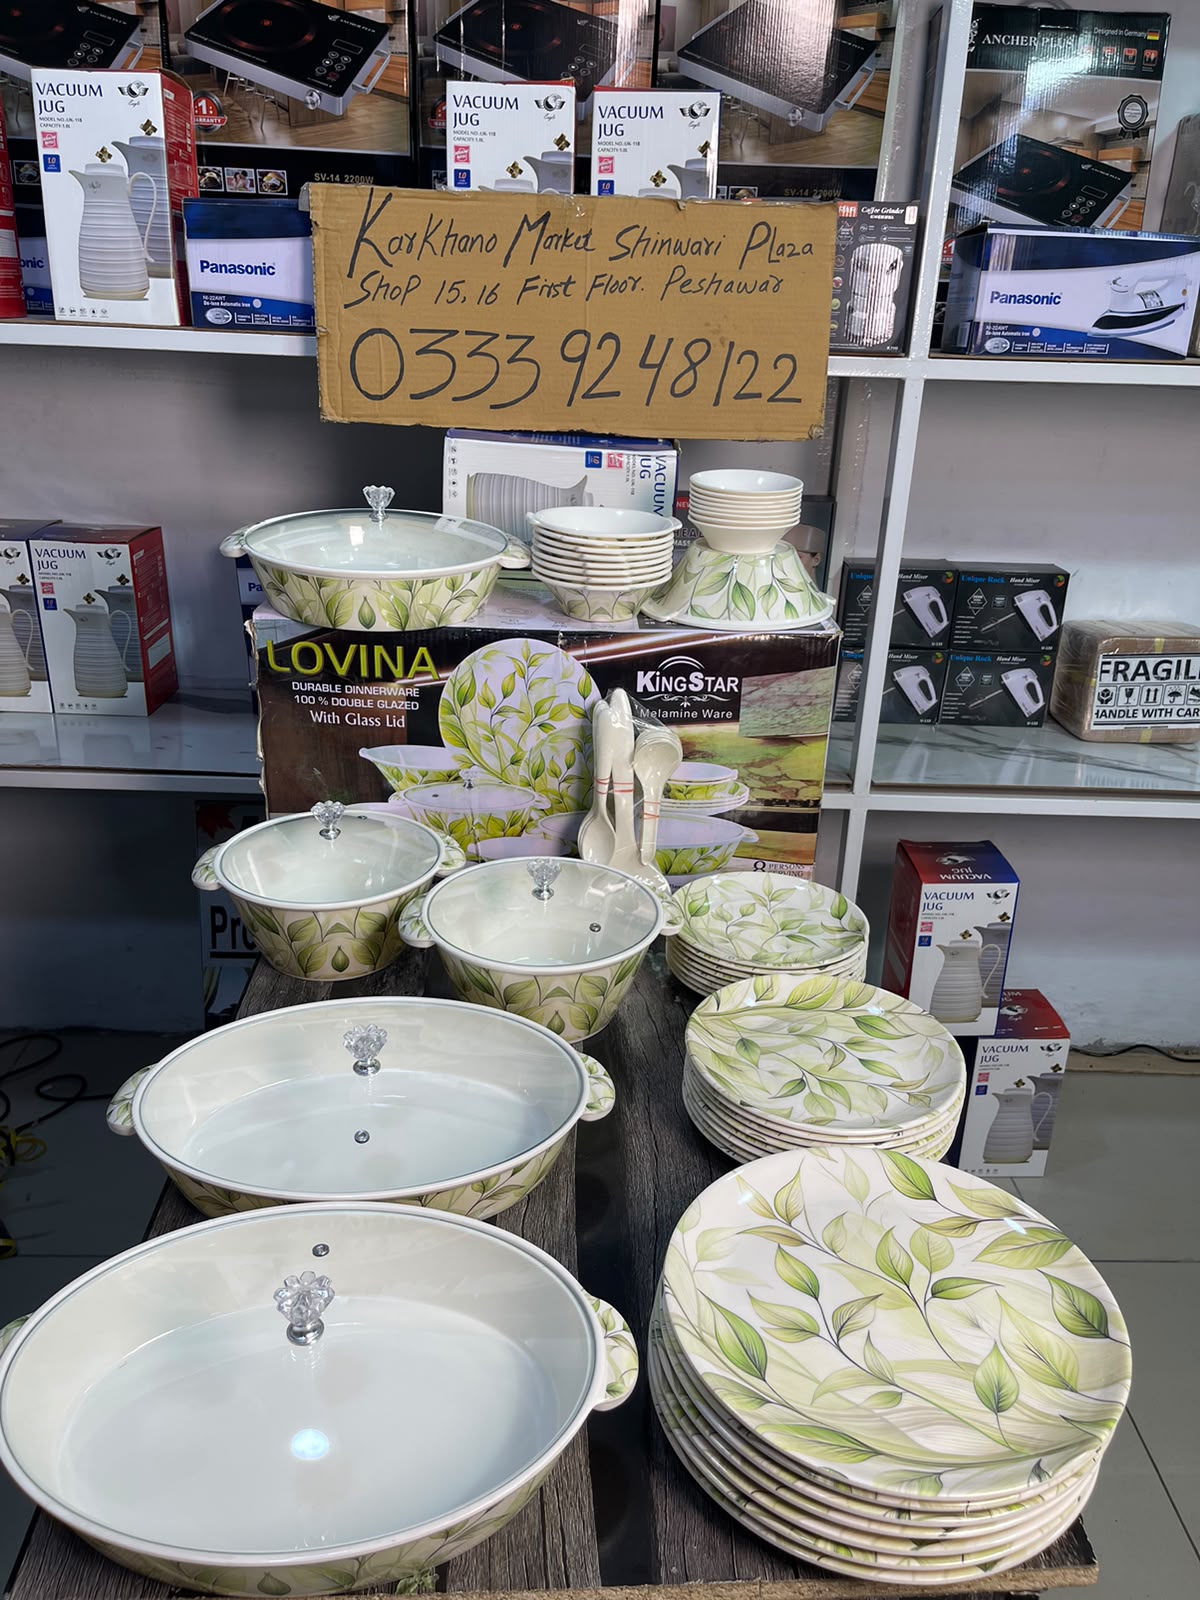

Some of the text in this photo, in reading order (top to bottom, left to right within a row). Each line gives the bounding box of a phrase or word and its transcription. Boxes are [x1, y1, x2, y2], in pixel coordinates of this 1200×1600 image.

[982, 34, 1038, 47] ANCHER
[36, 82, 103, 97] VACUUM
[39, 100, 65, 115] JUG
[453, 95, 519, 111] VACUUM
[598, 106, 664, 119] VACUUM
[453, 113, 480, 129] JUG
[598, 124, 625, 140] JUG
[314, 172, 374, 184] SV-14 2200W
[784, 188, 809, 197] SV-14
[861, 206, 881, 215] Coffee
[608, 224, 726, 262] Shinwari
[200, 260, 276, 276] Panasonic
[660, 265, 784, 302] Peshawar
[990, 291, 1062, 305] Panasonic
[674, 528, 704, 538] HEA
[35, 549, 86, 559] VACUUM
[37, 561, 58, 571] JUG
[266, 640, 442, 681] LOVINA
[1100, 659, 1200, 681] FRAGIL
[292, 681, 420, 698] DURABLE DINNERWARE
[294, 695, 420, 711] 100 % DOUBLE GLAZED
[309, 710, 406, 728] With Glass Lid
[640, 708, 733, 719] Melamine Ware
[1142, 708, 1173, 718] WITH
[1176, 708, 1200, 718] CAR
[924, 892, 975, 900] VACUUM
[922, 903, 943, 913] JUG
[982, 1045, 1029, 1054] VACUUM
[980, 1055, 1000, 1064] JUG
